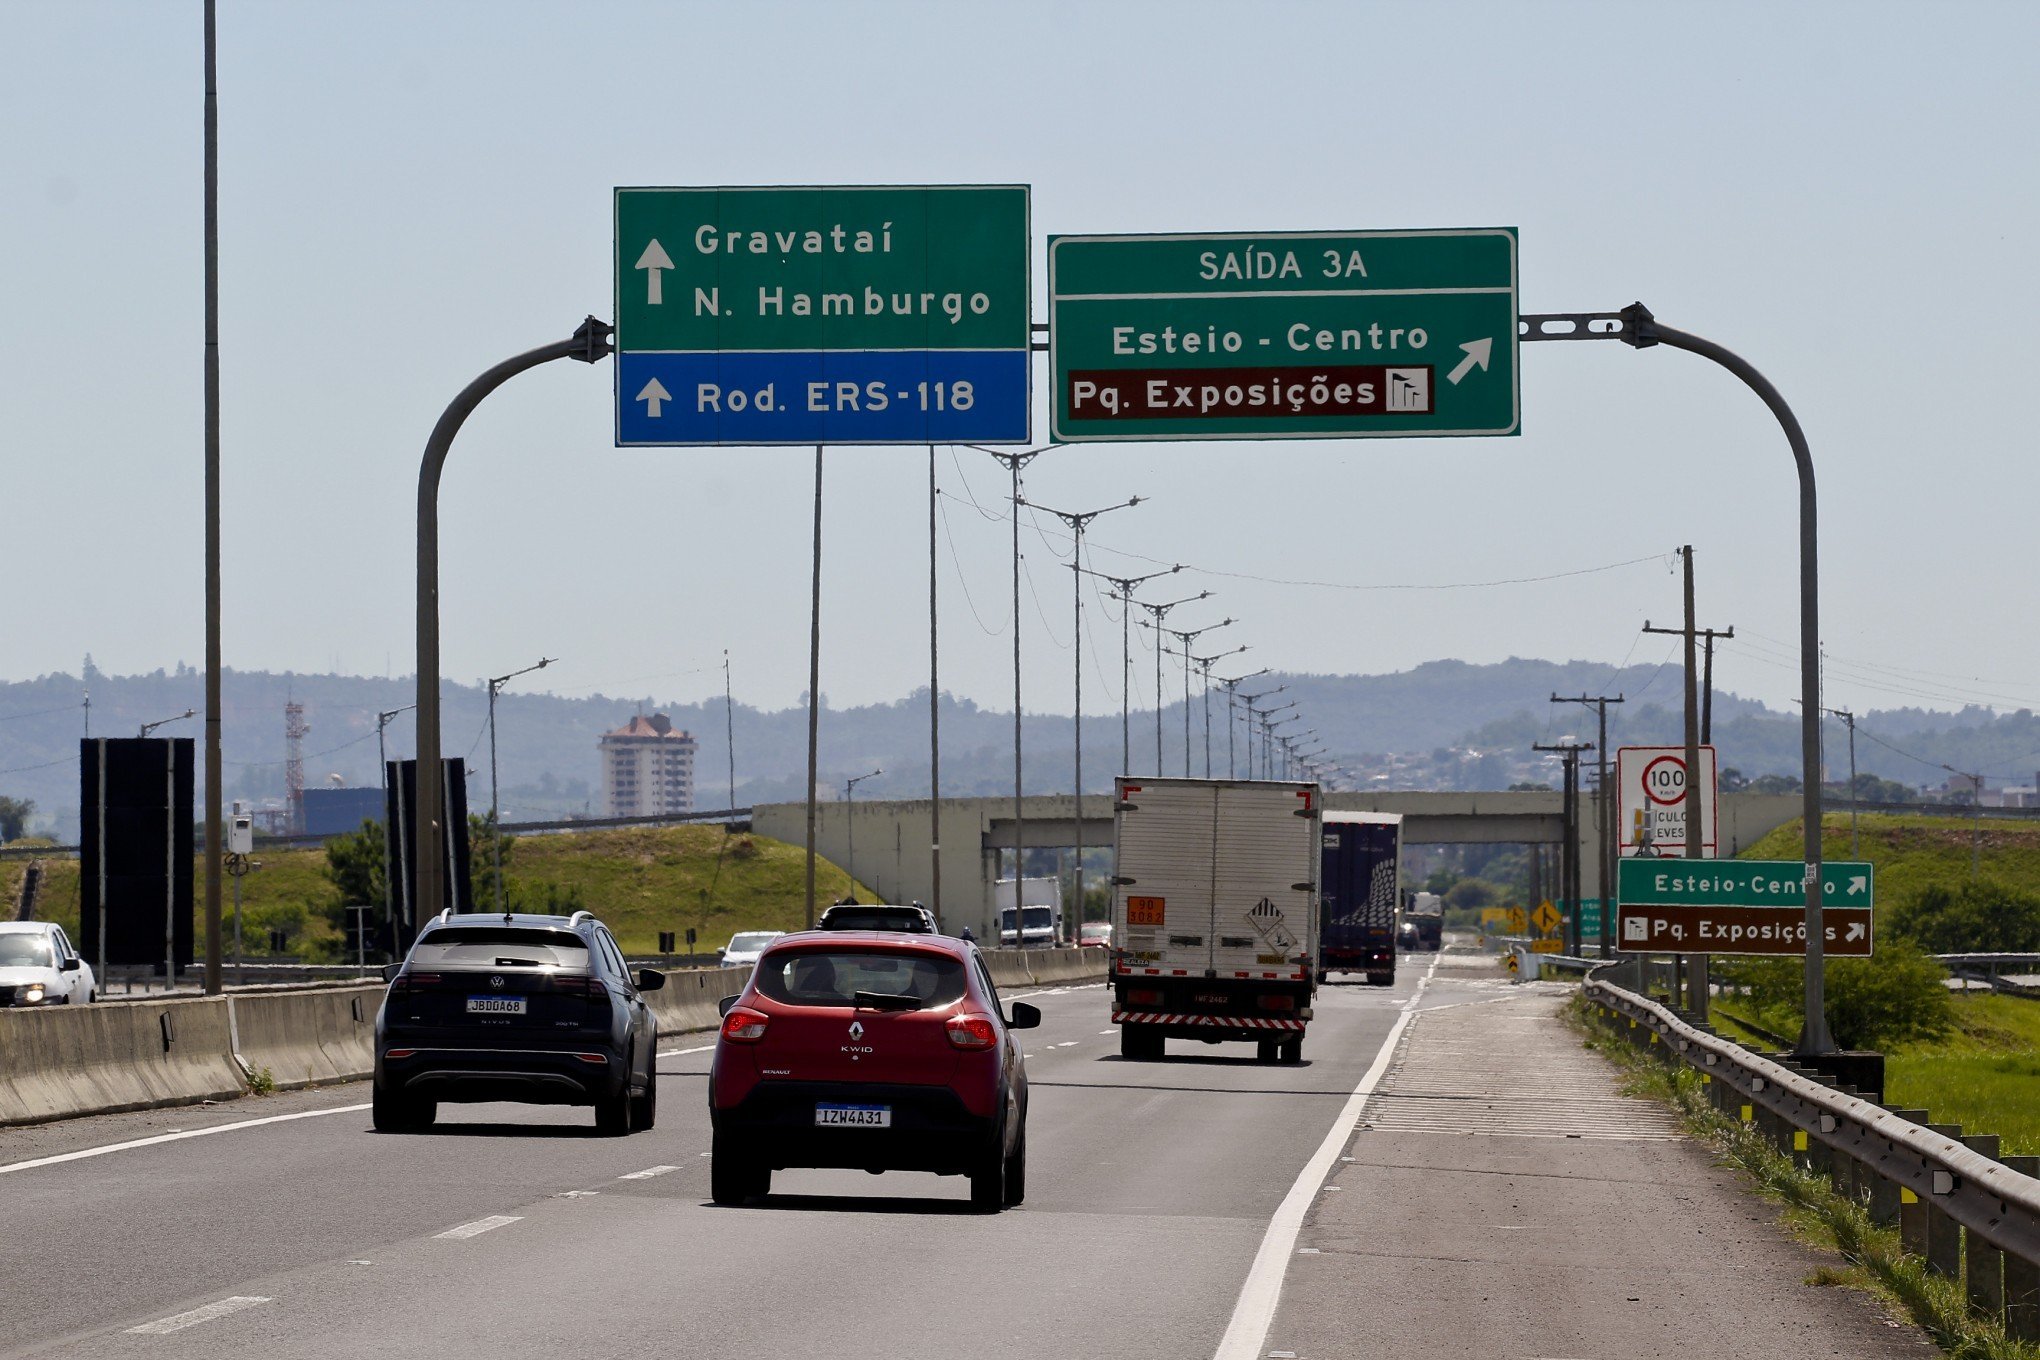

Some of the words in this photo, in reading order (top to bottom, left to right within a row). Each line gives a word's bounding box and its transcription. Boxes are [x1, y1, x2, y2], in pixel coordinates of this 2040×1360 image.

[695, 221, 893, 254] Gravataí
[1199, 245, 1302, 281] SAÍDA
[1322, 250, 1368, 279] 3A
[694, 286, 733, 317] N.
[759, 285, 991, 325] Hamburgo
[1112, 324, 1243, 355] Esteio
[1287, 321, 1429, 352] Centro
[697, 382, 786, 413] Rod.
[807, 380, 975, 412] ERS-118
[1072, 379, 1130, 415] Pq.
[1146, 374, 1376, 414] Exposições
[1651, 770, 1684, 787] 100
[1656, 827, 1685, 838] EVES
[1654, 874, 1836, 895] Esteio-Cento
[1139, 899, 1154, 910] 90
[1130, 911, 1162, 923] 3082
[1653, 918, 1688, 941] Pq.
[1699, 920, 1837, 943] Exposiçõs
[841, 1045, 873, 1053] KWID
[821, 1109, 883, 1125] IZW4A31
